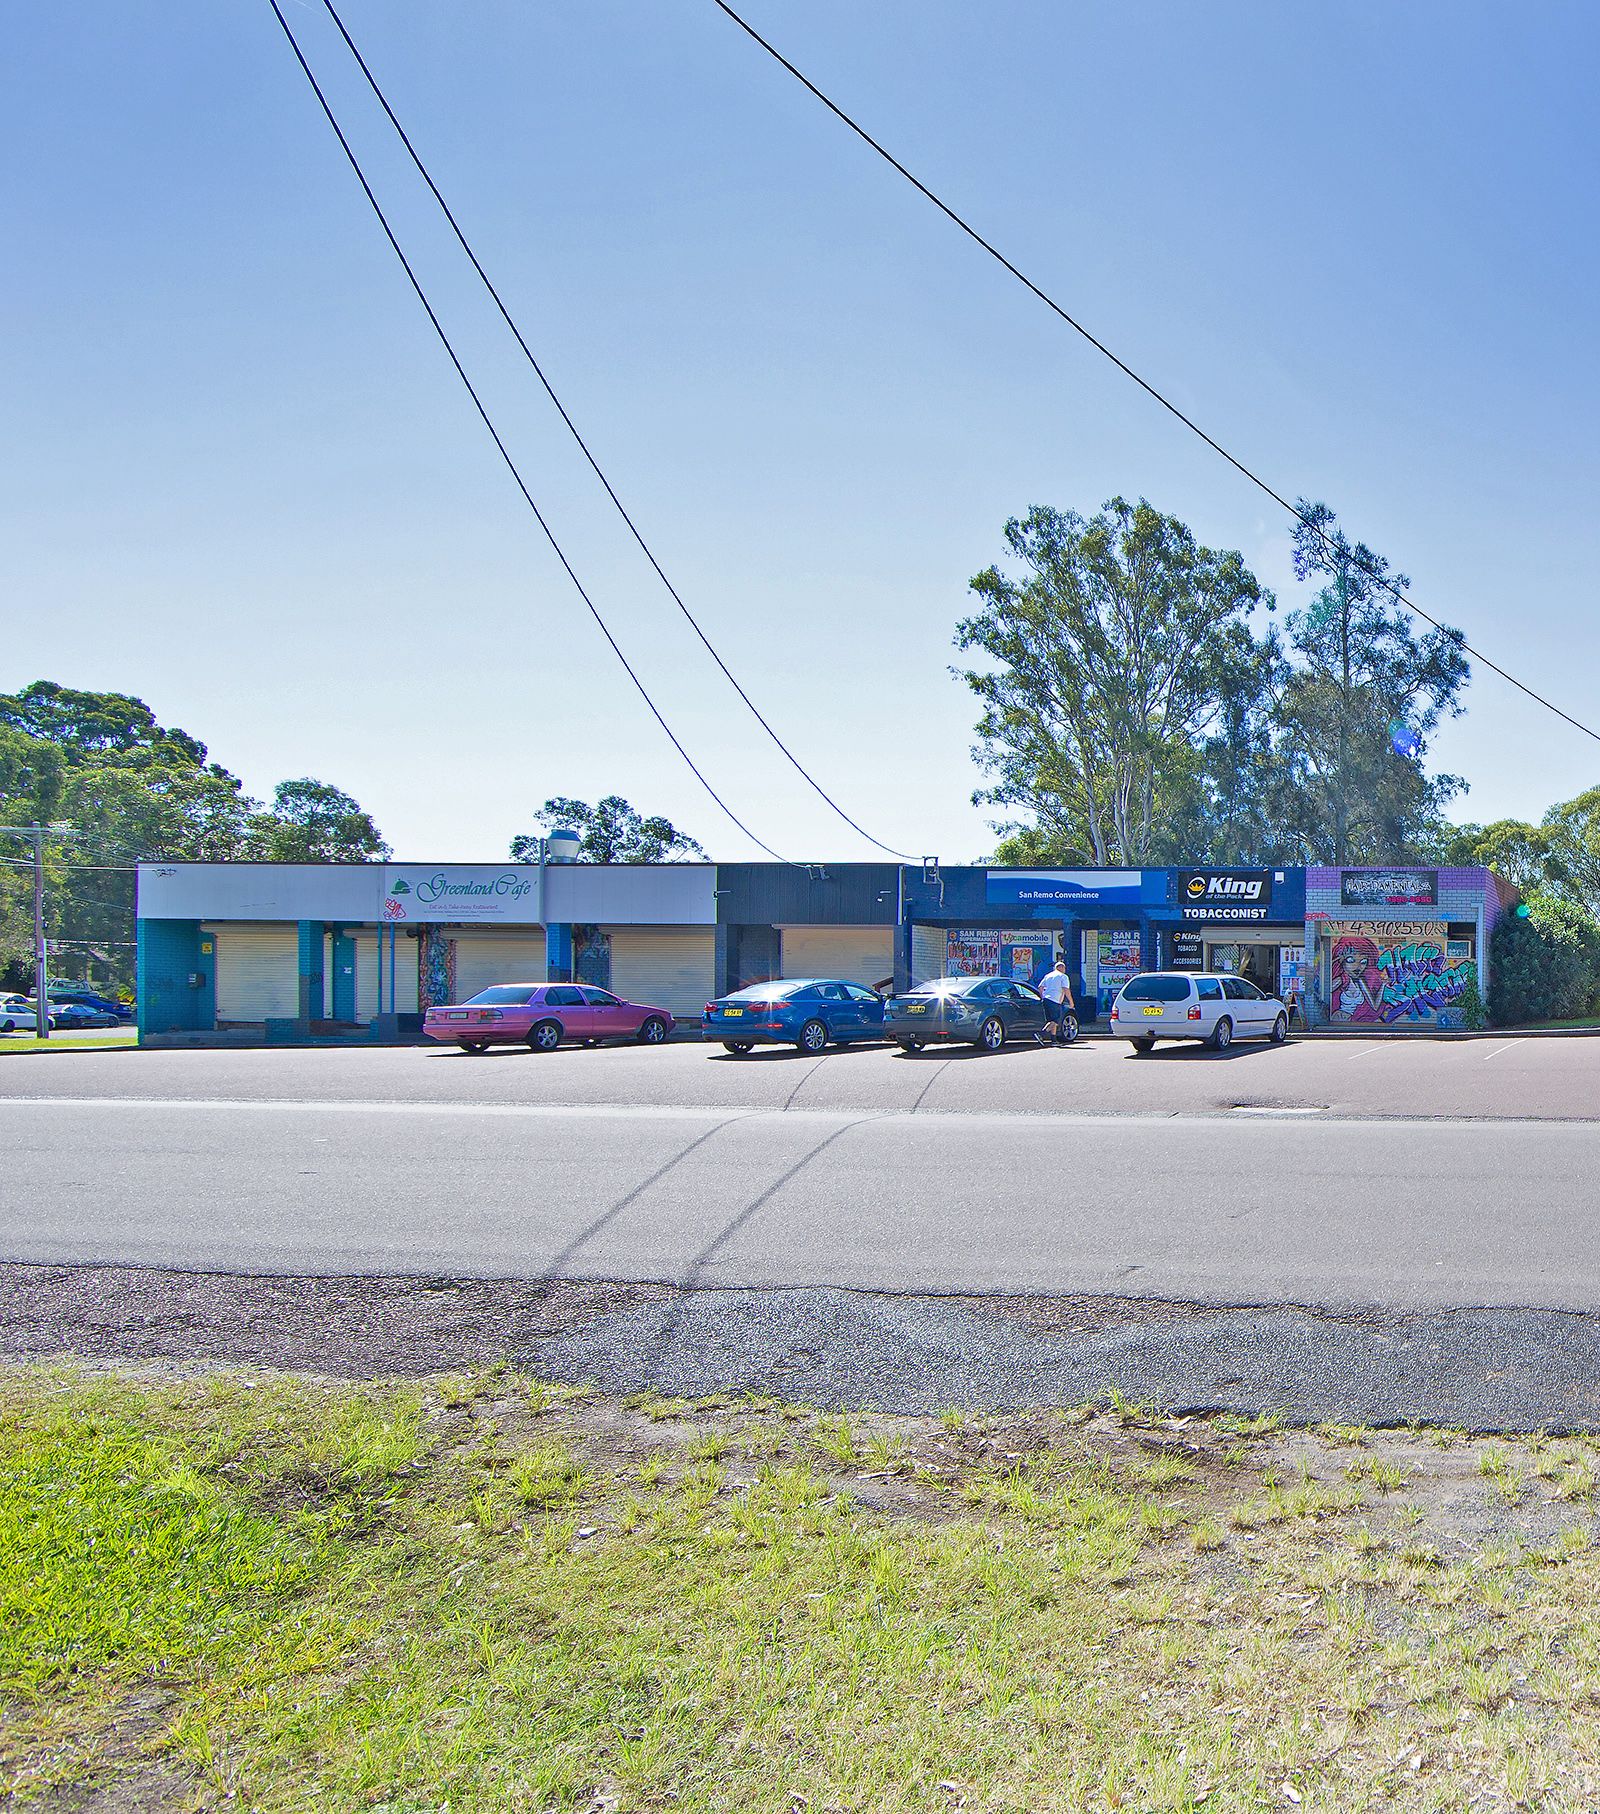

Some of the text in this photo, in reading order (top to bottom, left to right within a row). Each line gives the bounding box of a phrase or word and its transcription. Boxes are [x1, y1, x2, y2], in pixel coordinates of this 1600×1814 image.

[416, 873, 495, 902] Greenland
[1207, 877, 1263, 899] King
[1019, 891, 1099, 899] San Remo Convenience
[1184, 908, 1267, 918] TOBACCONIST
[1113, 932, 1132, 940] SAN
[1181, 933, 1201, 943] King
